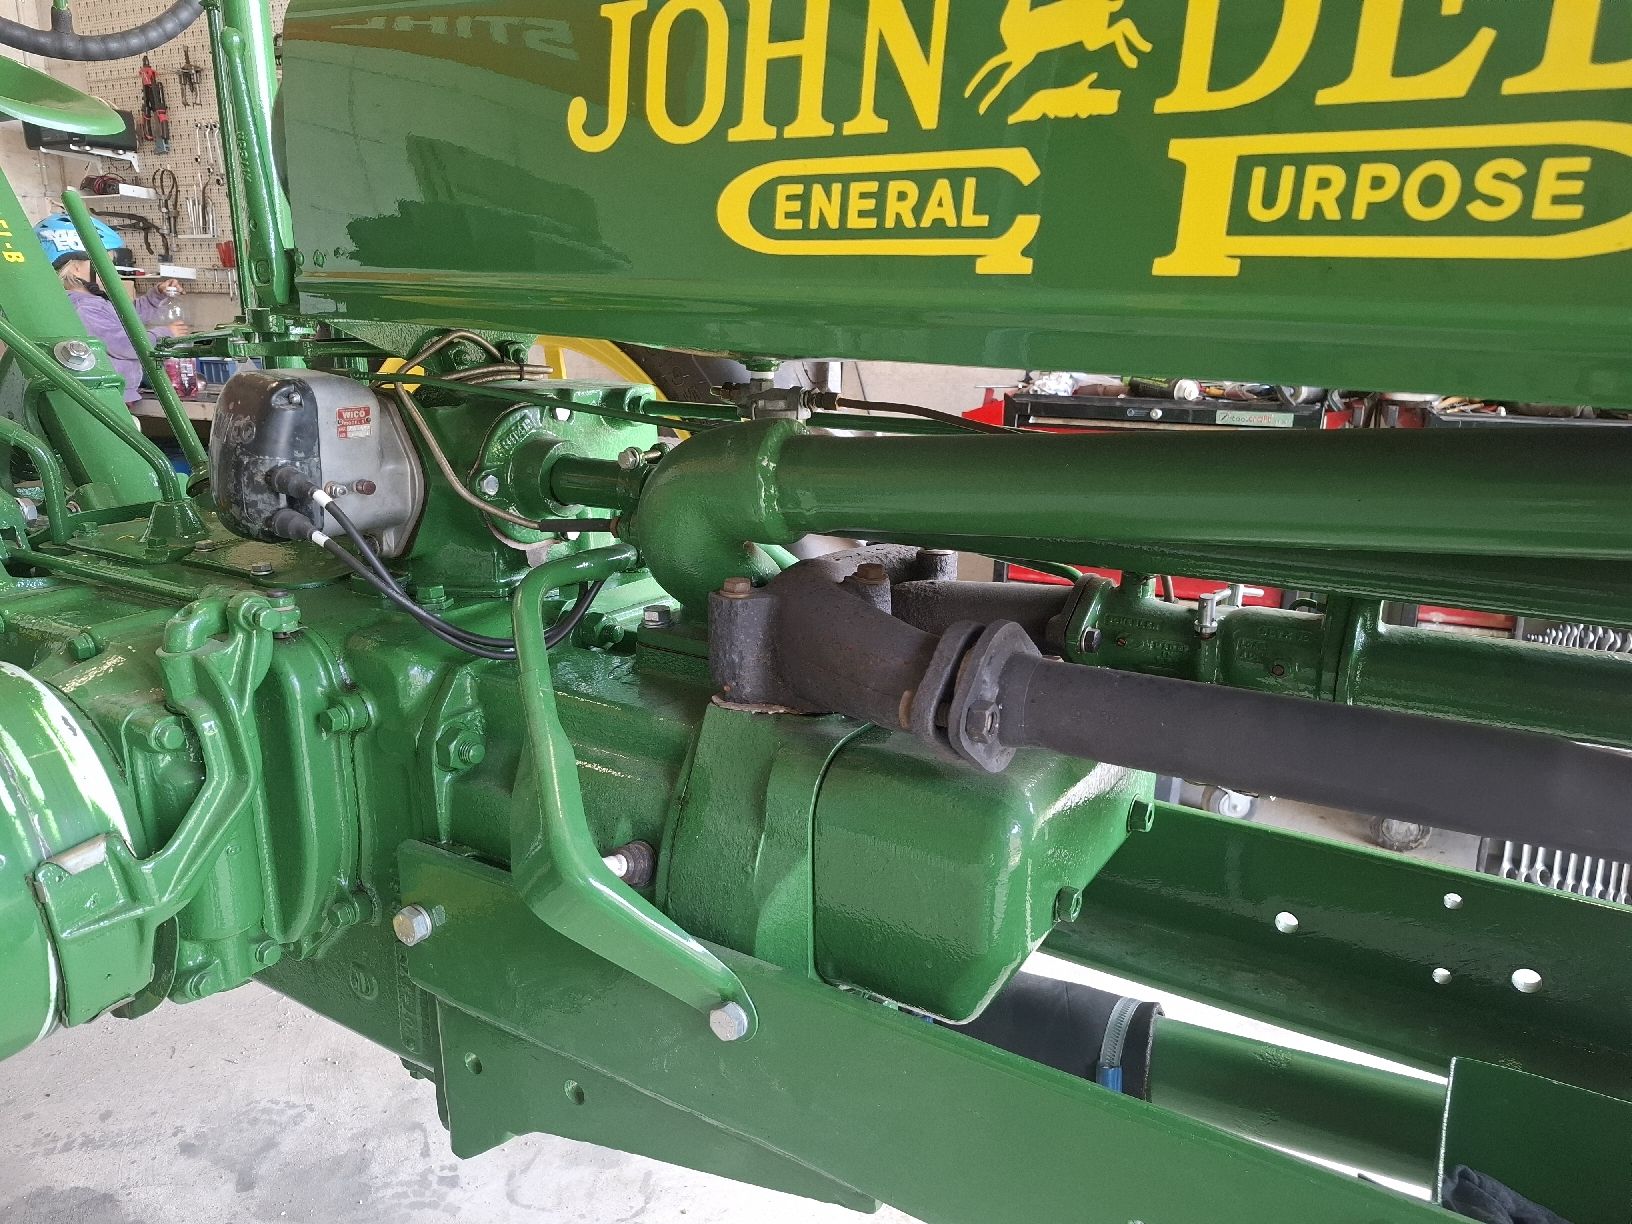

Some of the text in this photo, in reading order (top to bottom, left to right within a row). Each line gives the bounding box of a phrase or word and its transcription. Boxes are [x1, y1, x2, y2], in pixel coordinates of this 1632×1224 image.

[567, 0, 950, 153] JOHN
[715, 120, 1632, 277] GENERAL PURPOSE
[343, 411, 366, 419] WICO
